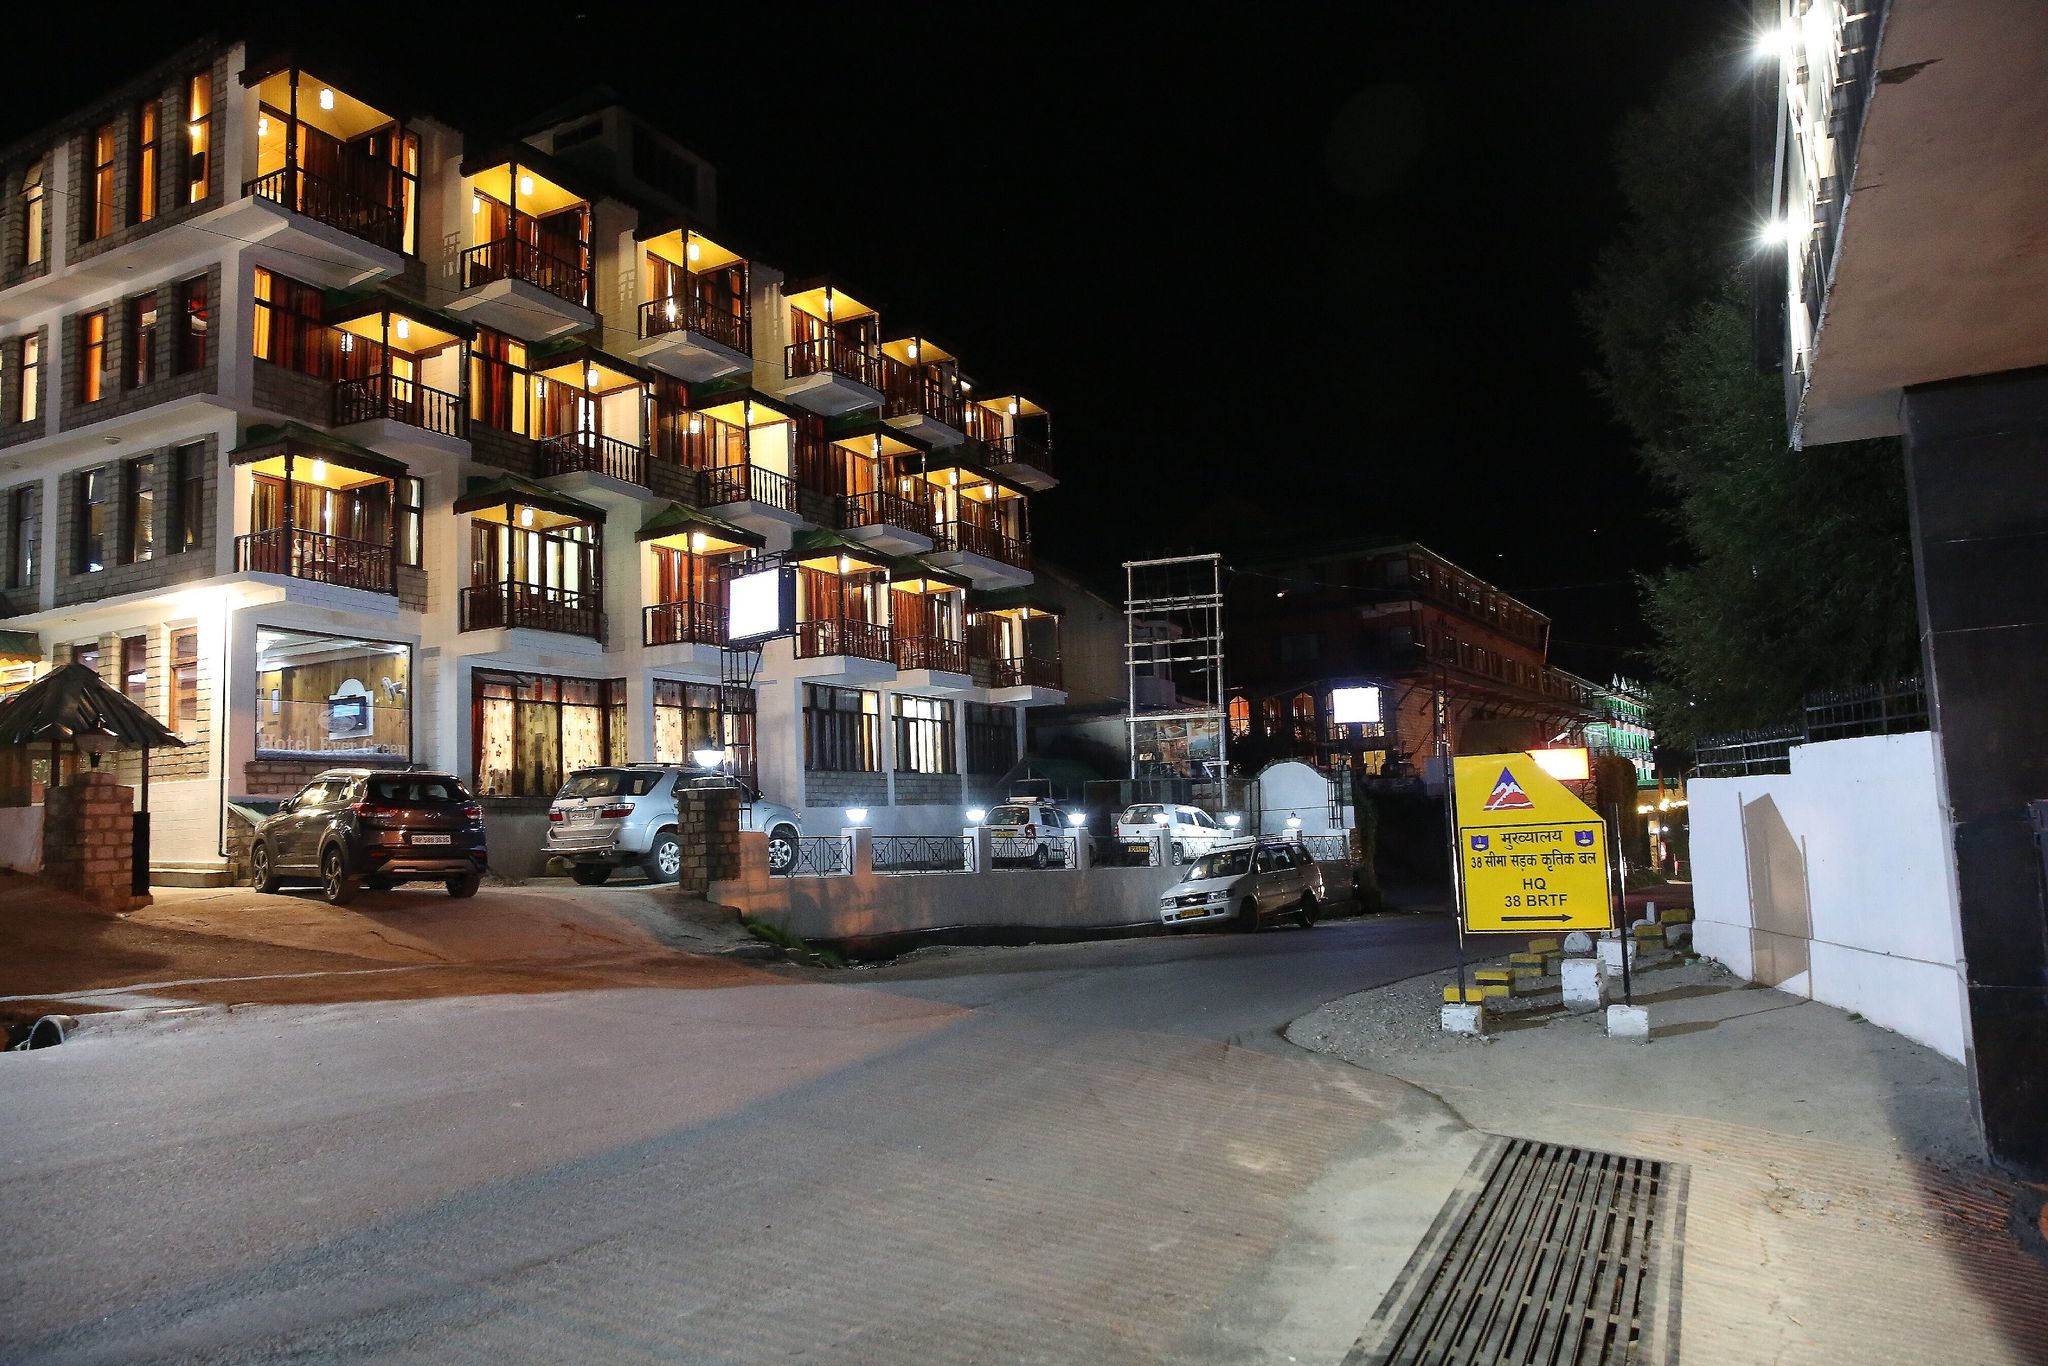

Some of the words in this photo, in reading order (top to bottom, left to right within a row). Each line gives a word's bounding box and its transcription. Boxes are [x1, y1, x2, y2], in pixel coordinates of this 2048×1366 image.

[260, 733, 311, 752] Hotel
[319, 736, 358, 752] Ever
[363, 738, 407, 755] Green
[1500, 830, 1563, 850] मुख्यालय
[1471, 857, 1482, 868] 38
[1484, 851, 1507, 867] सीमा
[1510, 854, 1537, 871] सड़क
[1577, 852, 1596, 865] बल
[1523, 877, 1546, 890] HQ
[1504, 895, 1521, 907] 38
[1526, 894, 1568, 907] BRTF
